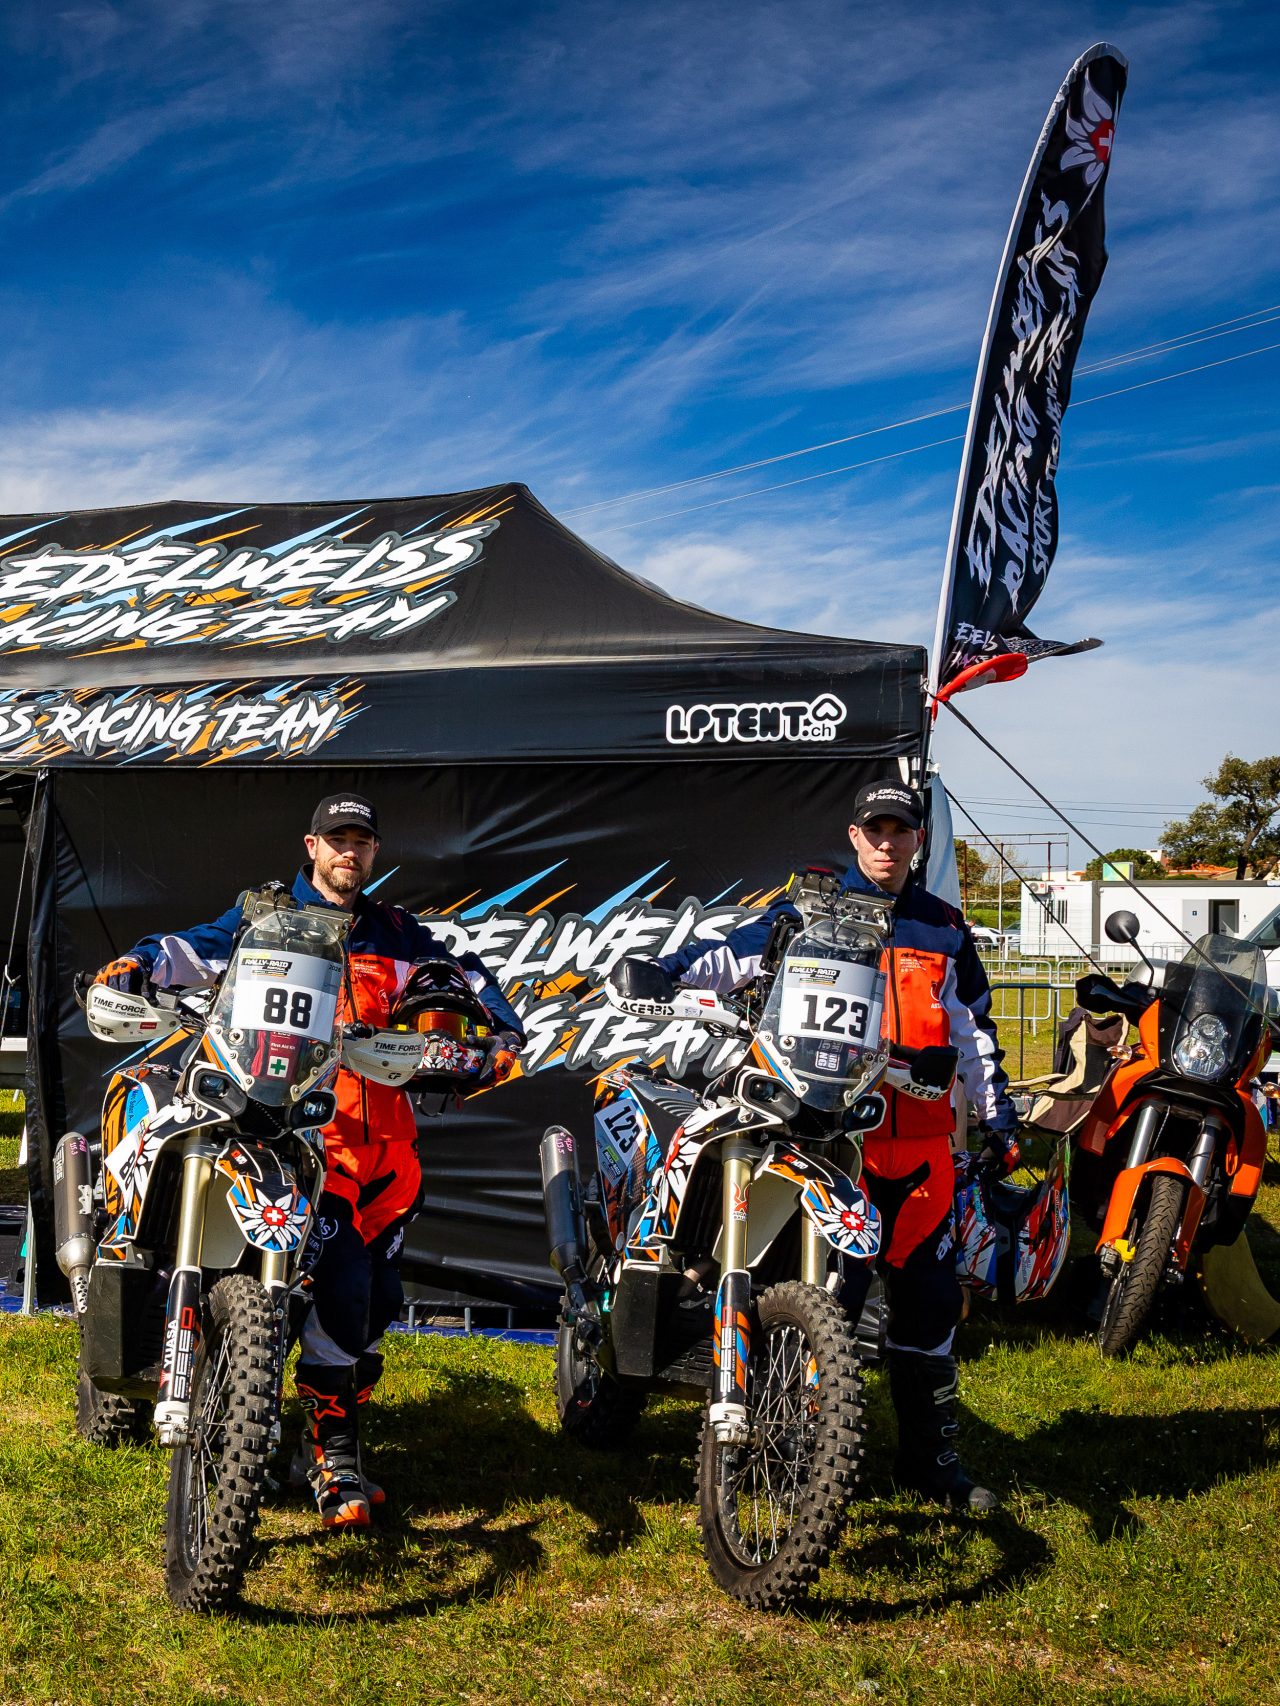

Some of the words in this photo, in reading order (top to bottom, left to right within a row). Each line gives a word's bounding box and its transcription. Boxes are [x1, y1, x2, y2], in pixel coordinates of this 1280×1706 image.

[217, 594, 453, 641] TEAM
[44, 697, 212, 753] RACING
[214, 696, 343, 753] TEAM
[245, 959, 289, 968] RALLY-RAID
[791, 966, 837, 976] RALLY-RAID
[93, 996, 113, 1008] TIME
[115, 1003, 147, 1014] FORCE
[263, 987, 313, 1030] 88
[801, 994, 869, 1039] 123
[374, 1042, 397, 1050] TIME
[398, 1044, 421, 1052] FORCE
[604, 1106, 642, 1154] 123
[163, 1320, 177, 1369] YUASA
[174, 1306, 194, 1399] SEED
[720, 1306, 732, 1393] SEED
